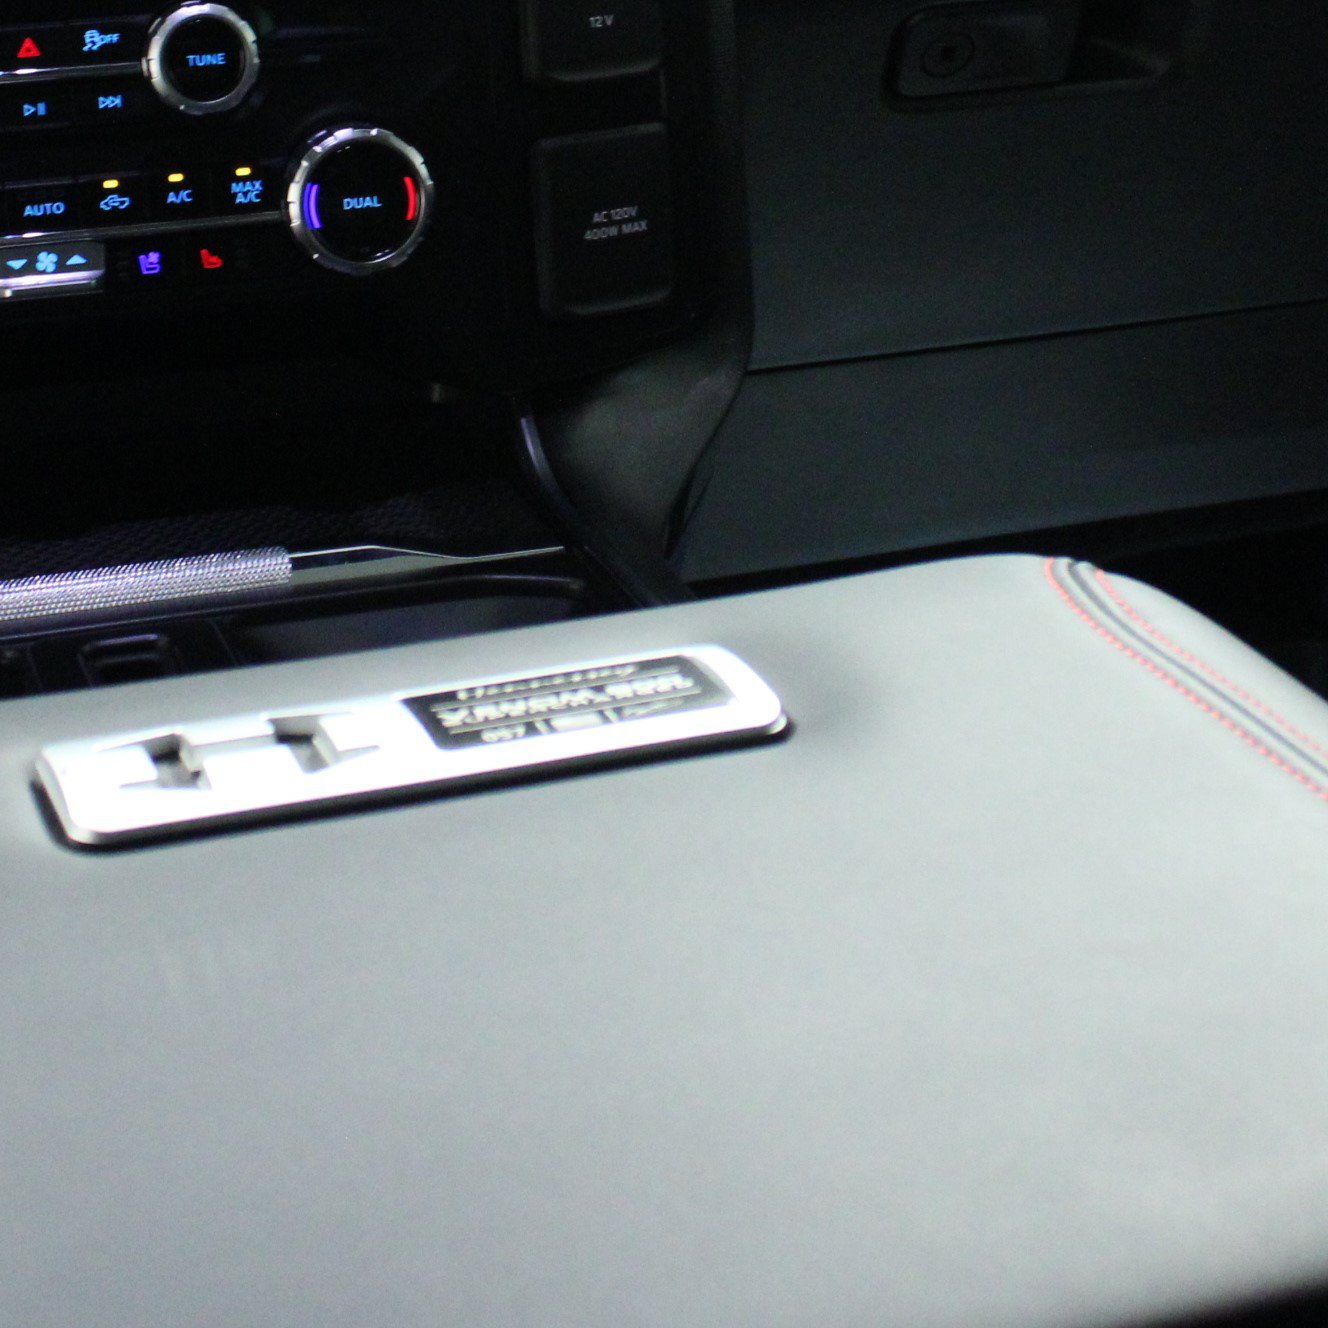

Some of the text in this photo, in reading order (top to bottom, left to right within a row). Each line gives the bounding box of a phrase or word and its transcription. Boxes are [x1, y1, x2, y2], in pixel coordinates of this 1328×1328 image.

[98, 33, 121, 46] OFF
[185, 52, 227, 67] TUNE
[230, 180, 263, 194] MAX
[166, 189, 193, 205] A/C
[234, 192, 262, 204] A/C
[342, 195, 383, 210] DUAL
[23, 201, 66, 217] AUTO
